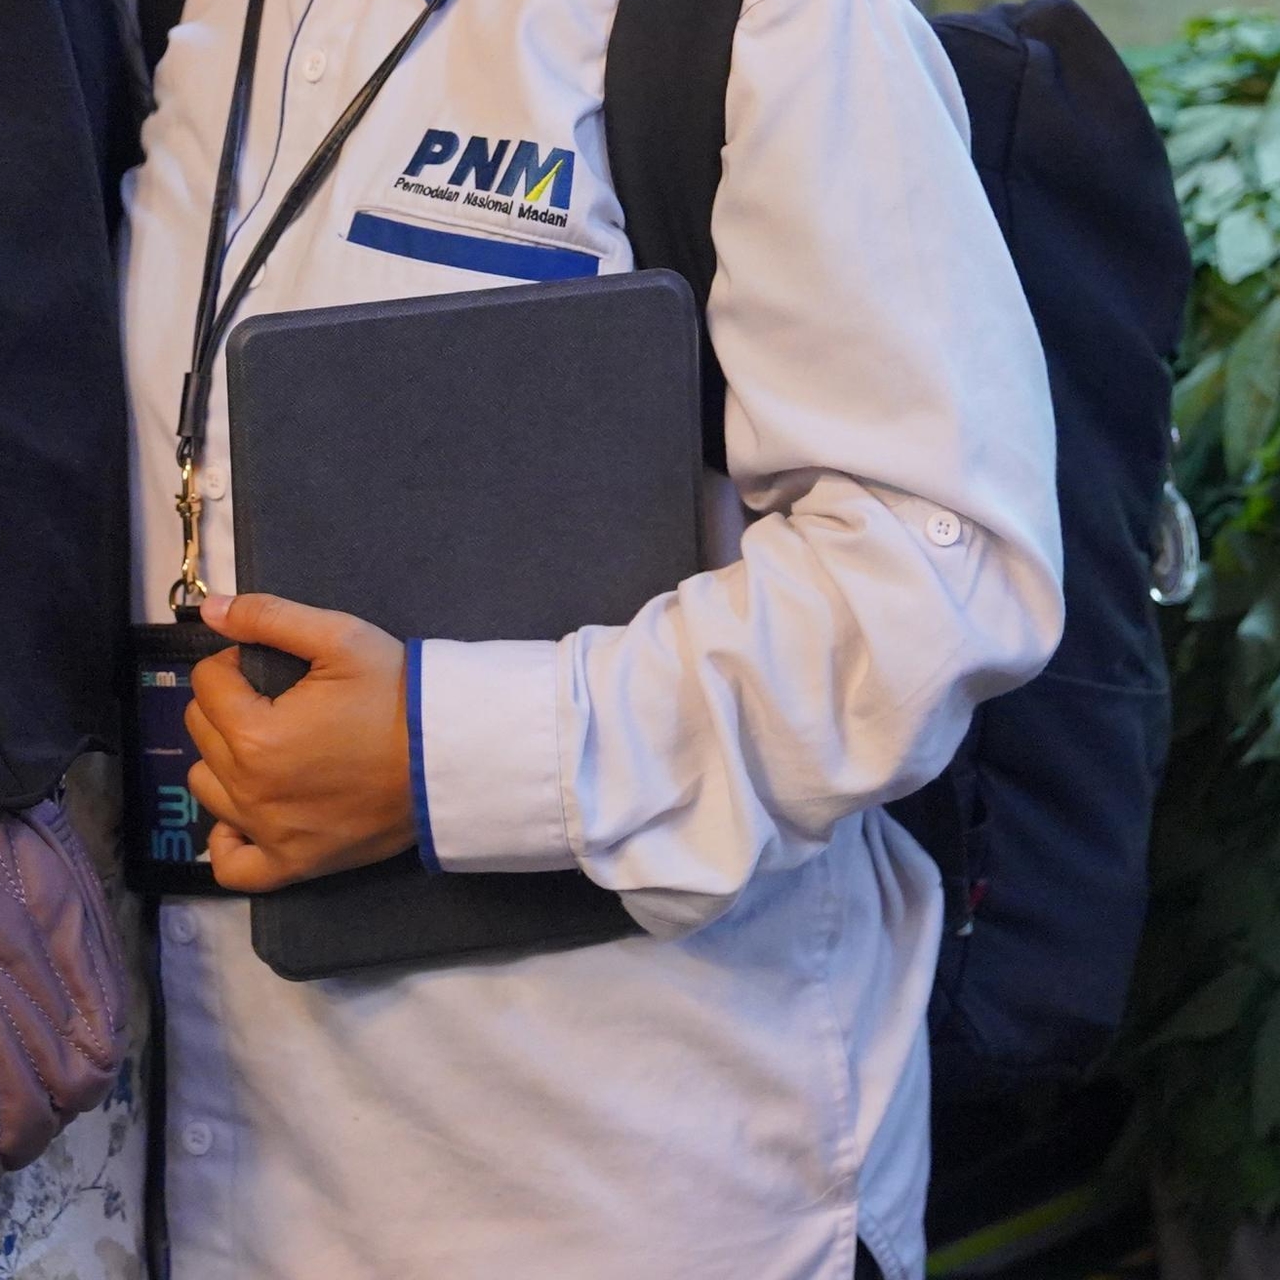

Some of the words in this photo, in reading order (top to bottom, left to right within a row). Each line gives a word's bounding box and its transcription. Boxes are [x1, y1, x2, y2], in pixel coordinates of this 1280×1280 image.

[403, 128, 576, 210] PNM
[394, 177, 460, 202] Permodalan
[464, 193, 513, 215] Nasional
[518, 203, 568, 228] Madani
